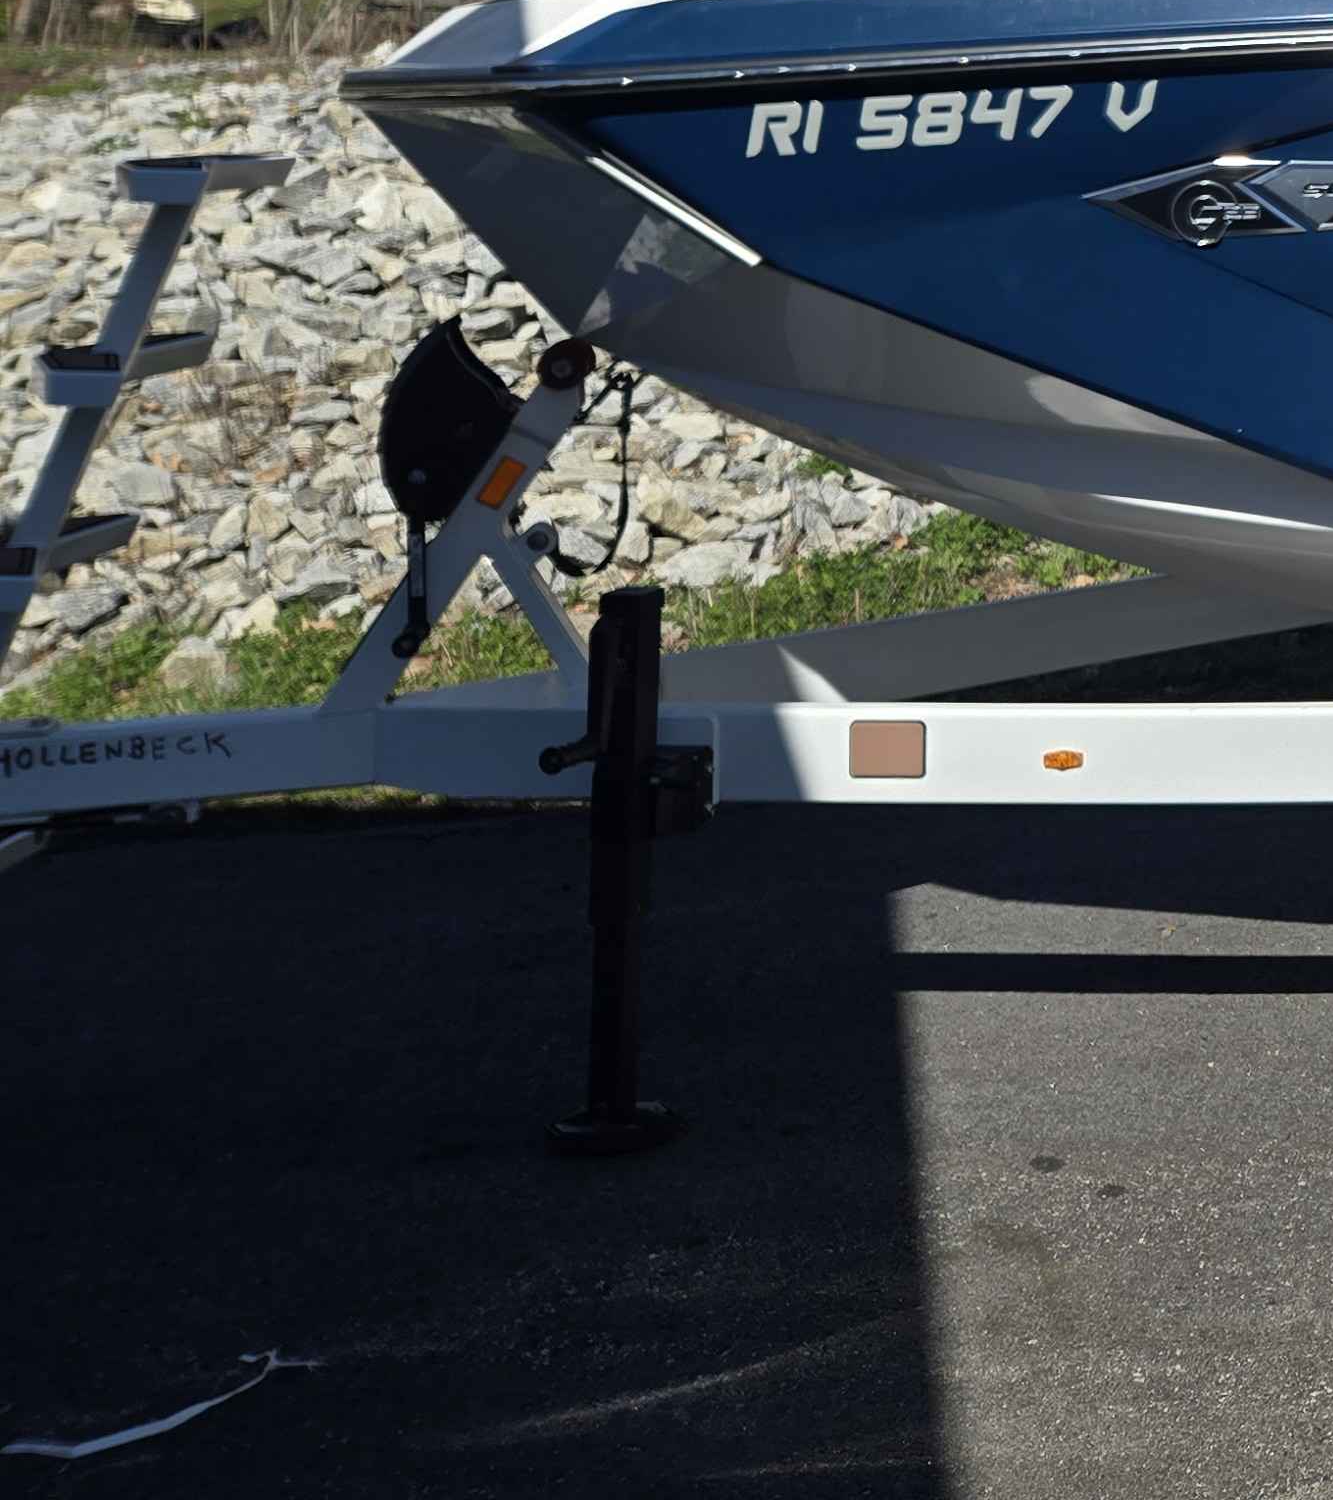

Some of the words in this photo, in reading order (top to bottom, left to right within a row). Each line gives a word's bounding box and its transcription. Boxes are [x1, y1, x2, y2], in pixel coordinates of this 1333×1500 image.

[745, 99, 824, 158] RI
[855, 84, 1074, 151] 5847
[1105, 79, 1159, 133] V
